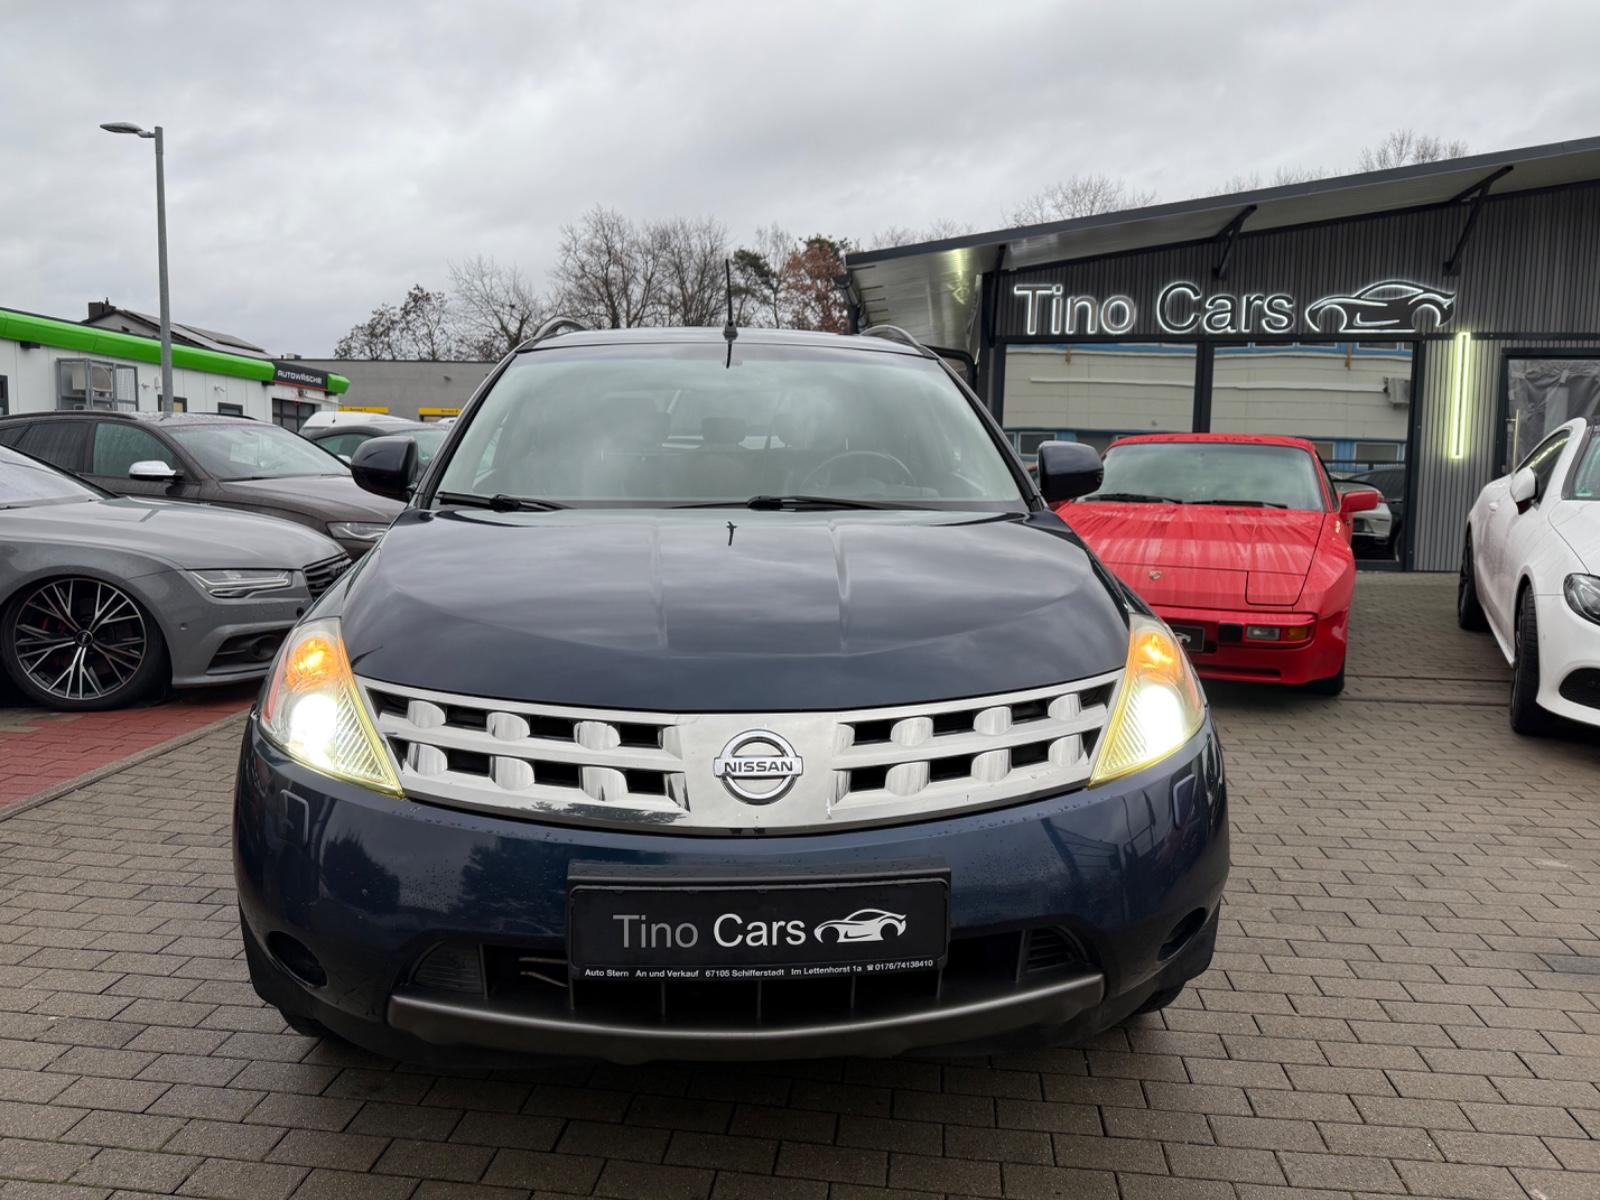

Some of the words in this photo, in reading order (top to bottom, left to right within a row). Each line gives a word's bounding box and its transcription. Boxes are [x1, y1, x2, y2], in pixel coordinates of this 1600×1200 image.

[1013, 283, 1136, 336] Tino
[1156, 281, 1296, 334] Cars
[724, 761, 793, 772] NISSAN
[612, 914, 698, 948] Tino
[713, 913, 806, 947] Cars
[584, 968, 605, 976] Auto
[606, 969, 630, 978] Stern
[635, 969, 648, 978] An
[649, 969, 665, 978] und
[666, 969, 699, 978] Verkauf
[705, 969, 730, 978] 67105
[731, 968, 785, 978] Schifferstadt
[791, 967, 802, 976] Im
[804, 965, 851, 976] Lettenhorst
[852, 965, 862, 973] 1a
